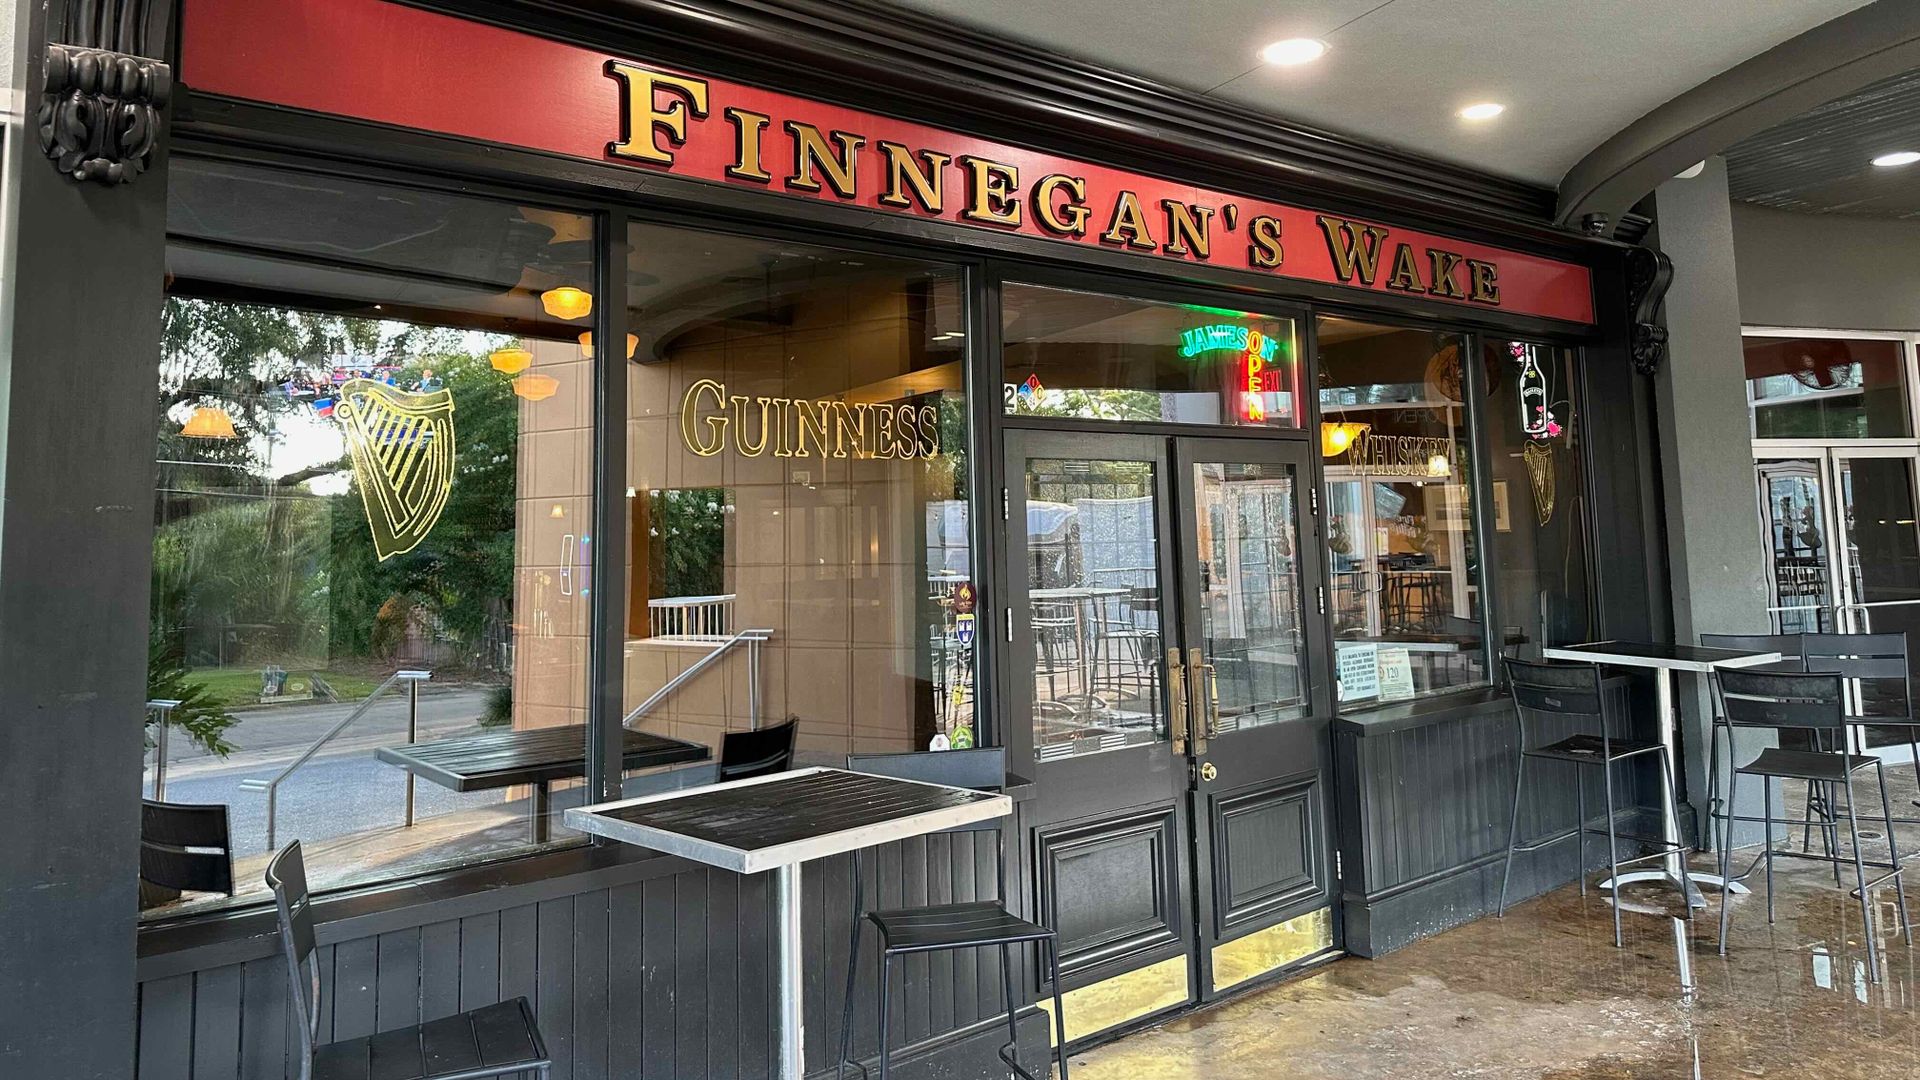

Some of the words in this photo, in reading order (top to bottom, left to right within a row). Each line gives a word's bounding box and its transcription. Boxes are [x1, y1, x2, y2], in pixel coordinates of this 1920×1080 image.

[602, 58, 1284, 269] FINNEGAN'S
[1316, 214, 1501, 305] WAKE
[1180, 324, 1279, 362] JAMESN
[1247, 330, 1264, 421] OPEN
[681, 378, 940, 461] GUINNESS
[1004, 385, 1015, 409] 2
[1346, 426, 1451, 476] WHISKEY
